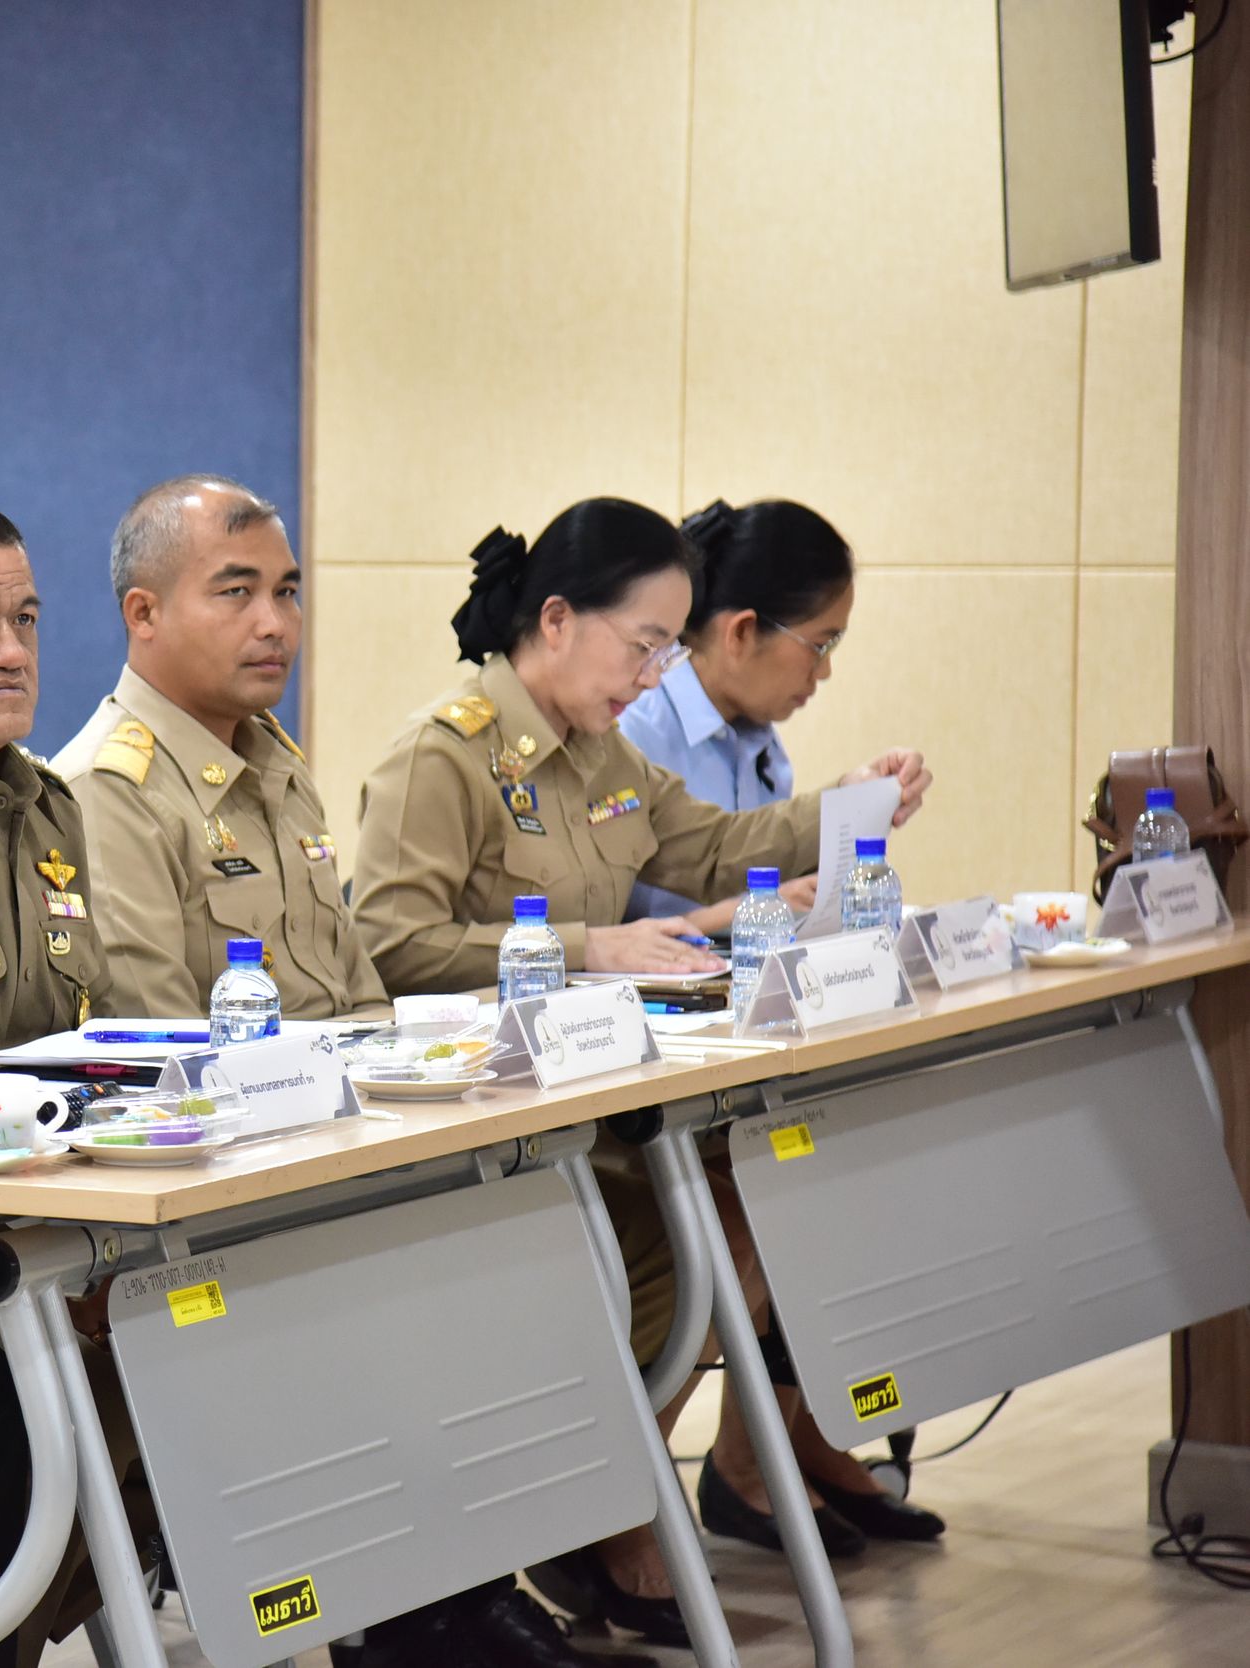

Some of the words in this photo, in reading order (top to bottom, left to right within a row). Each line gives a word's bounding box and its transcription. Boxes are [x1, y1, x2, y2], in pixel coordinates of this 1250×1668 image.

[856, 1381, 895, 1414] เมธาวี
[259, 1584, 311, 1626] เมธาวี
